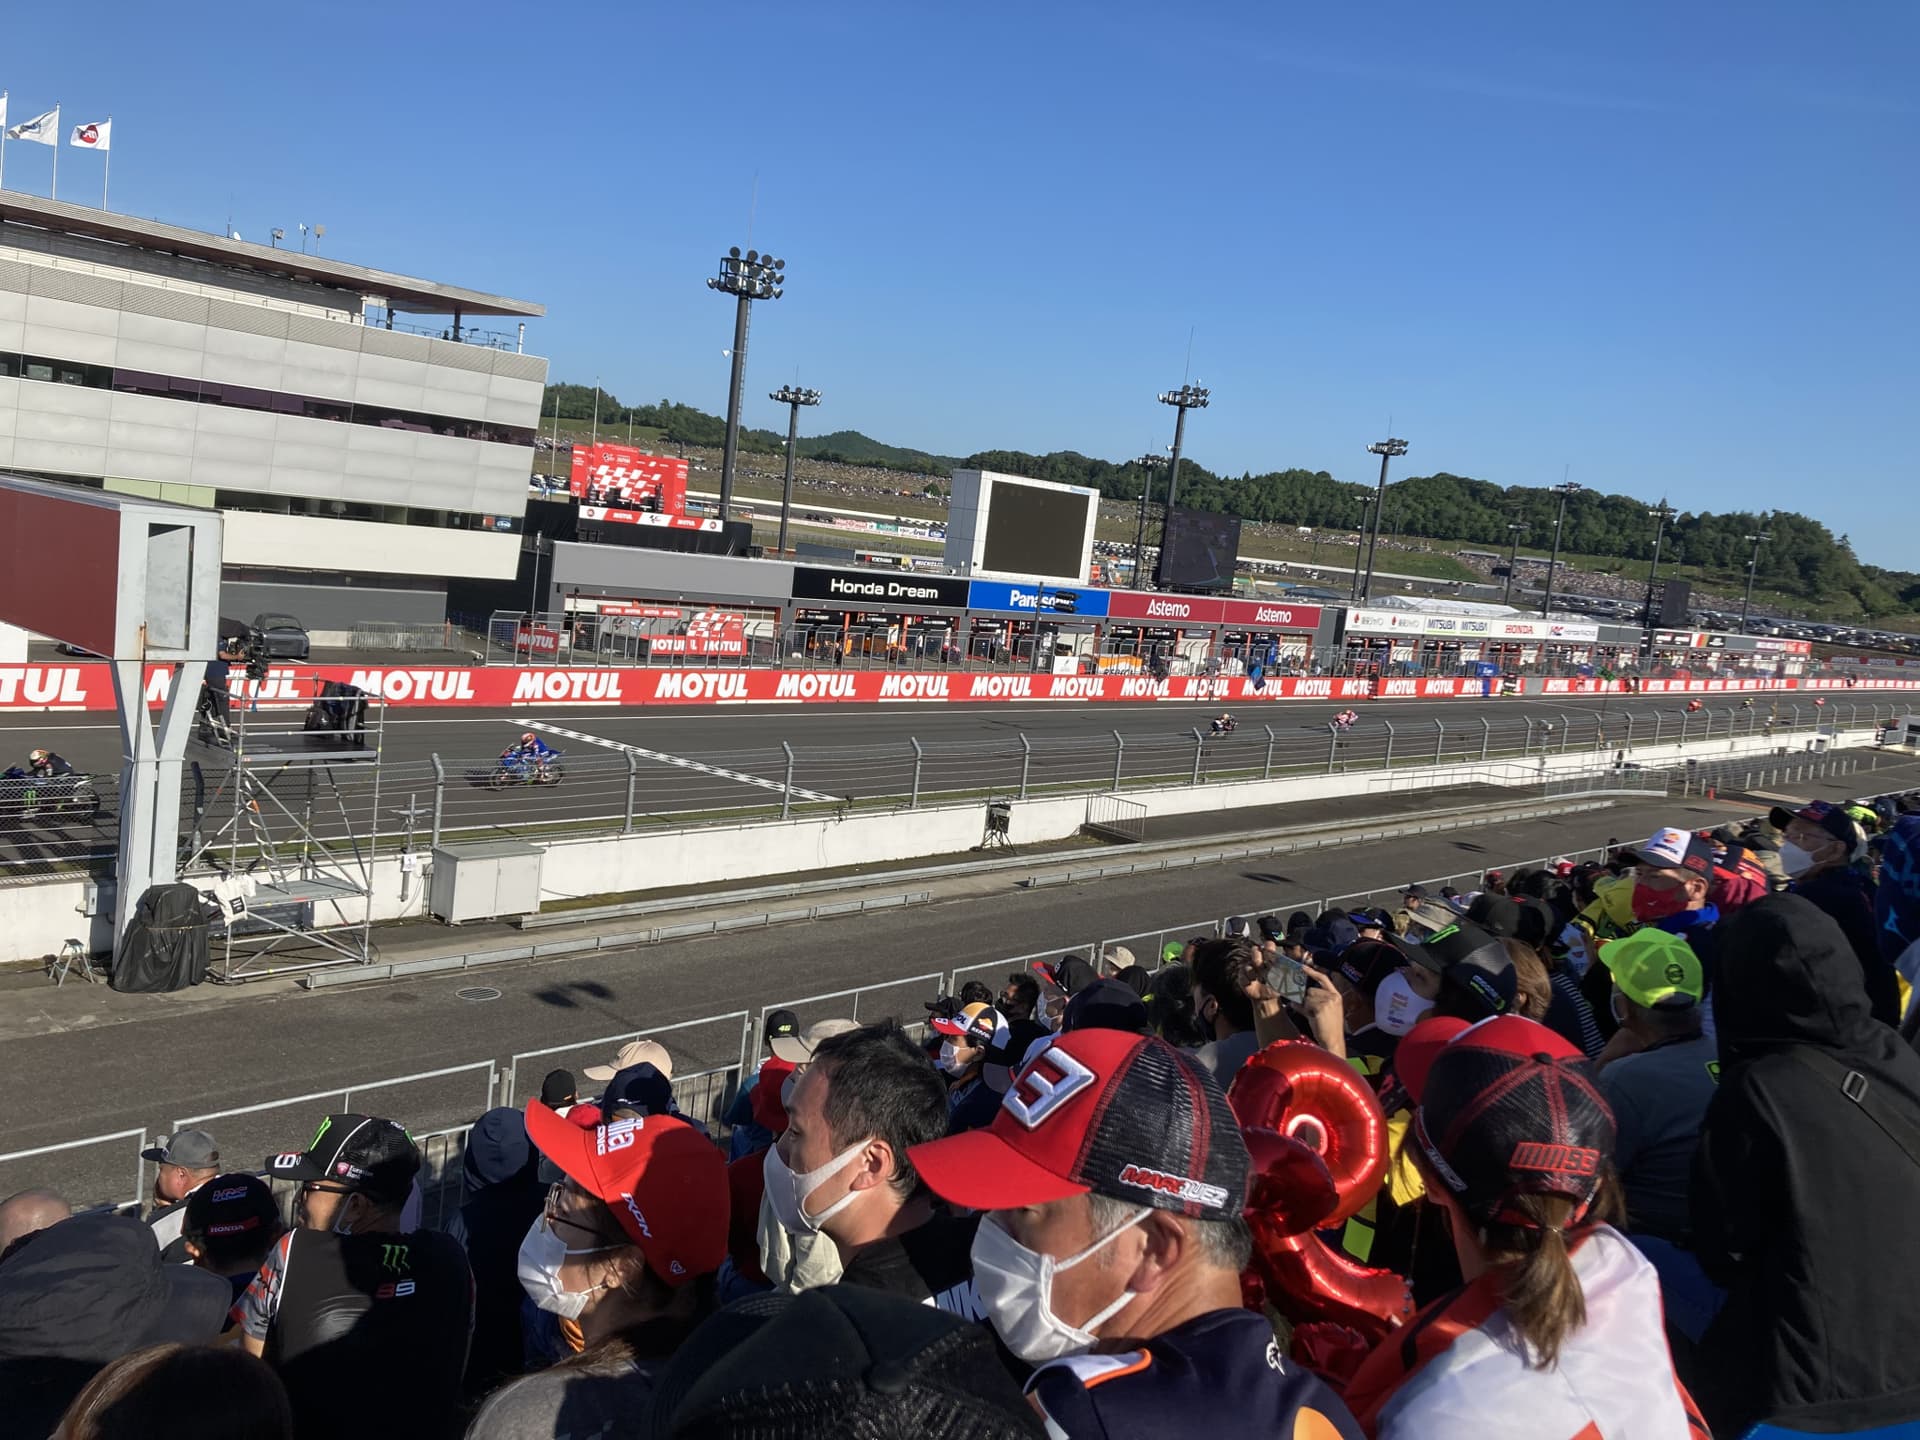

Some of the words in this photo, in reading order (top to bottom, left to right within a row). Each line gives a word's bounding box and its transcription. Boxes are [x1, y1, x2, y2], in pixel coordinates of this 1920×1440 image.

[831, 578, 884, 595] Honda
[888, 582, 938, 598] Dream
[1146, 599, 1190, 617] Astemo
[1255, 606, 1292, 623] Astemo
[1427, 618, 1456, 630] MITSUBA
[1461, 621, 1487, 632] MITSUBA
[1505, 624, 1533, 634] HONDA
[519, 633, 554, 648] MOTUL
[350, 671, 475, 700] MOTUL
[512, 672, 622, 699] MOTUL
[655, 673, 748, 698] MOTUL
[775, 674, 856, 697] MOTUL
[879, 675, 949, 696] MOTUL
[970, 676, 1031, 696] MOTUL
[1050, 677, 1104, 696] MOTUL
[1184, 679, 1229, 696] MOUL
[1294, 680, 1331, 695] MOTUL
[1385, 680, 1416, 695] MOTUL
[1425, 680, 1454, 694] MOTUL
[1120, 1165, 1228, 1208] MARQUEZ
[621, 1192, 652, 1238] IXON
[210, 1224, 245, 1233] HONDA
